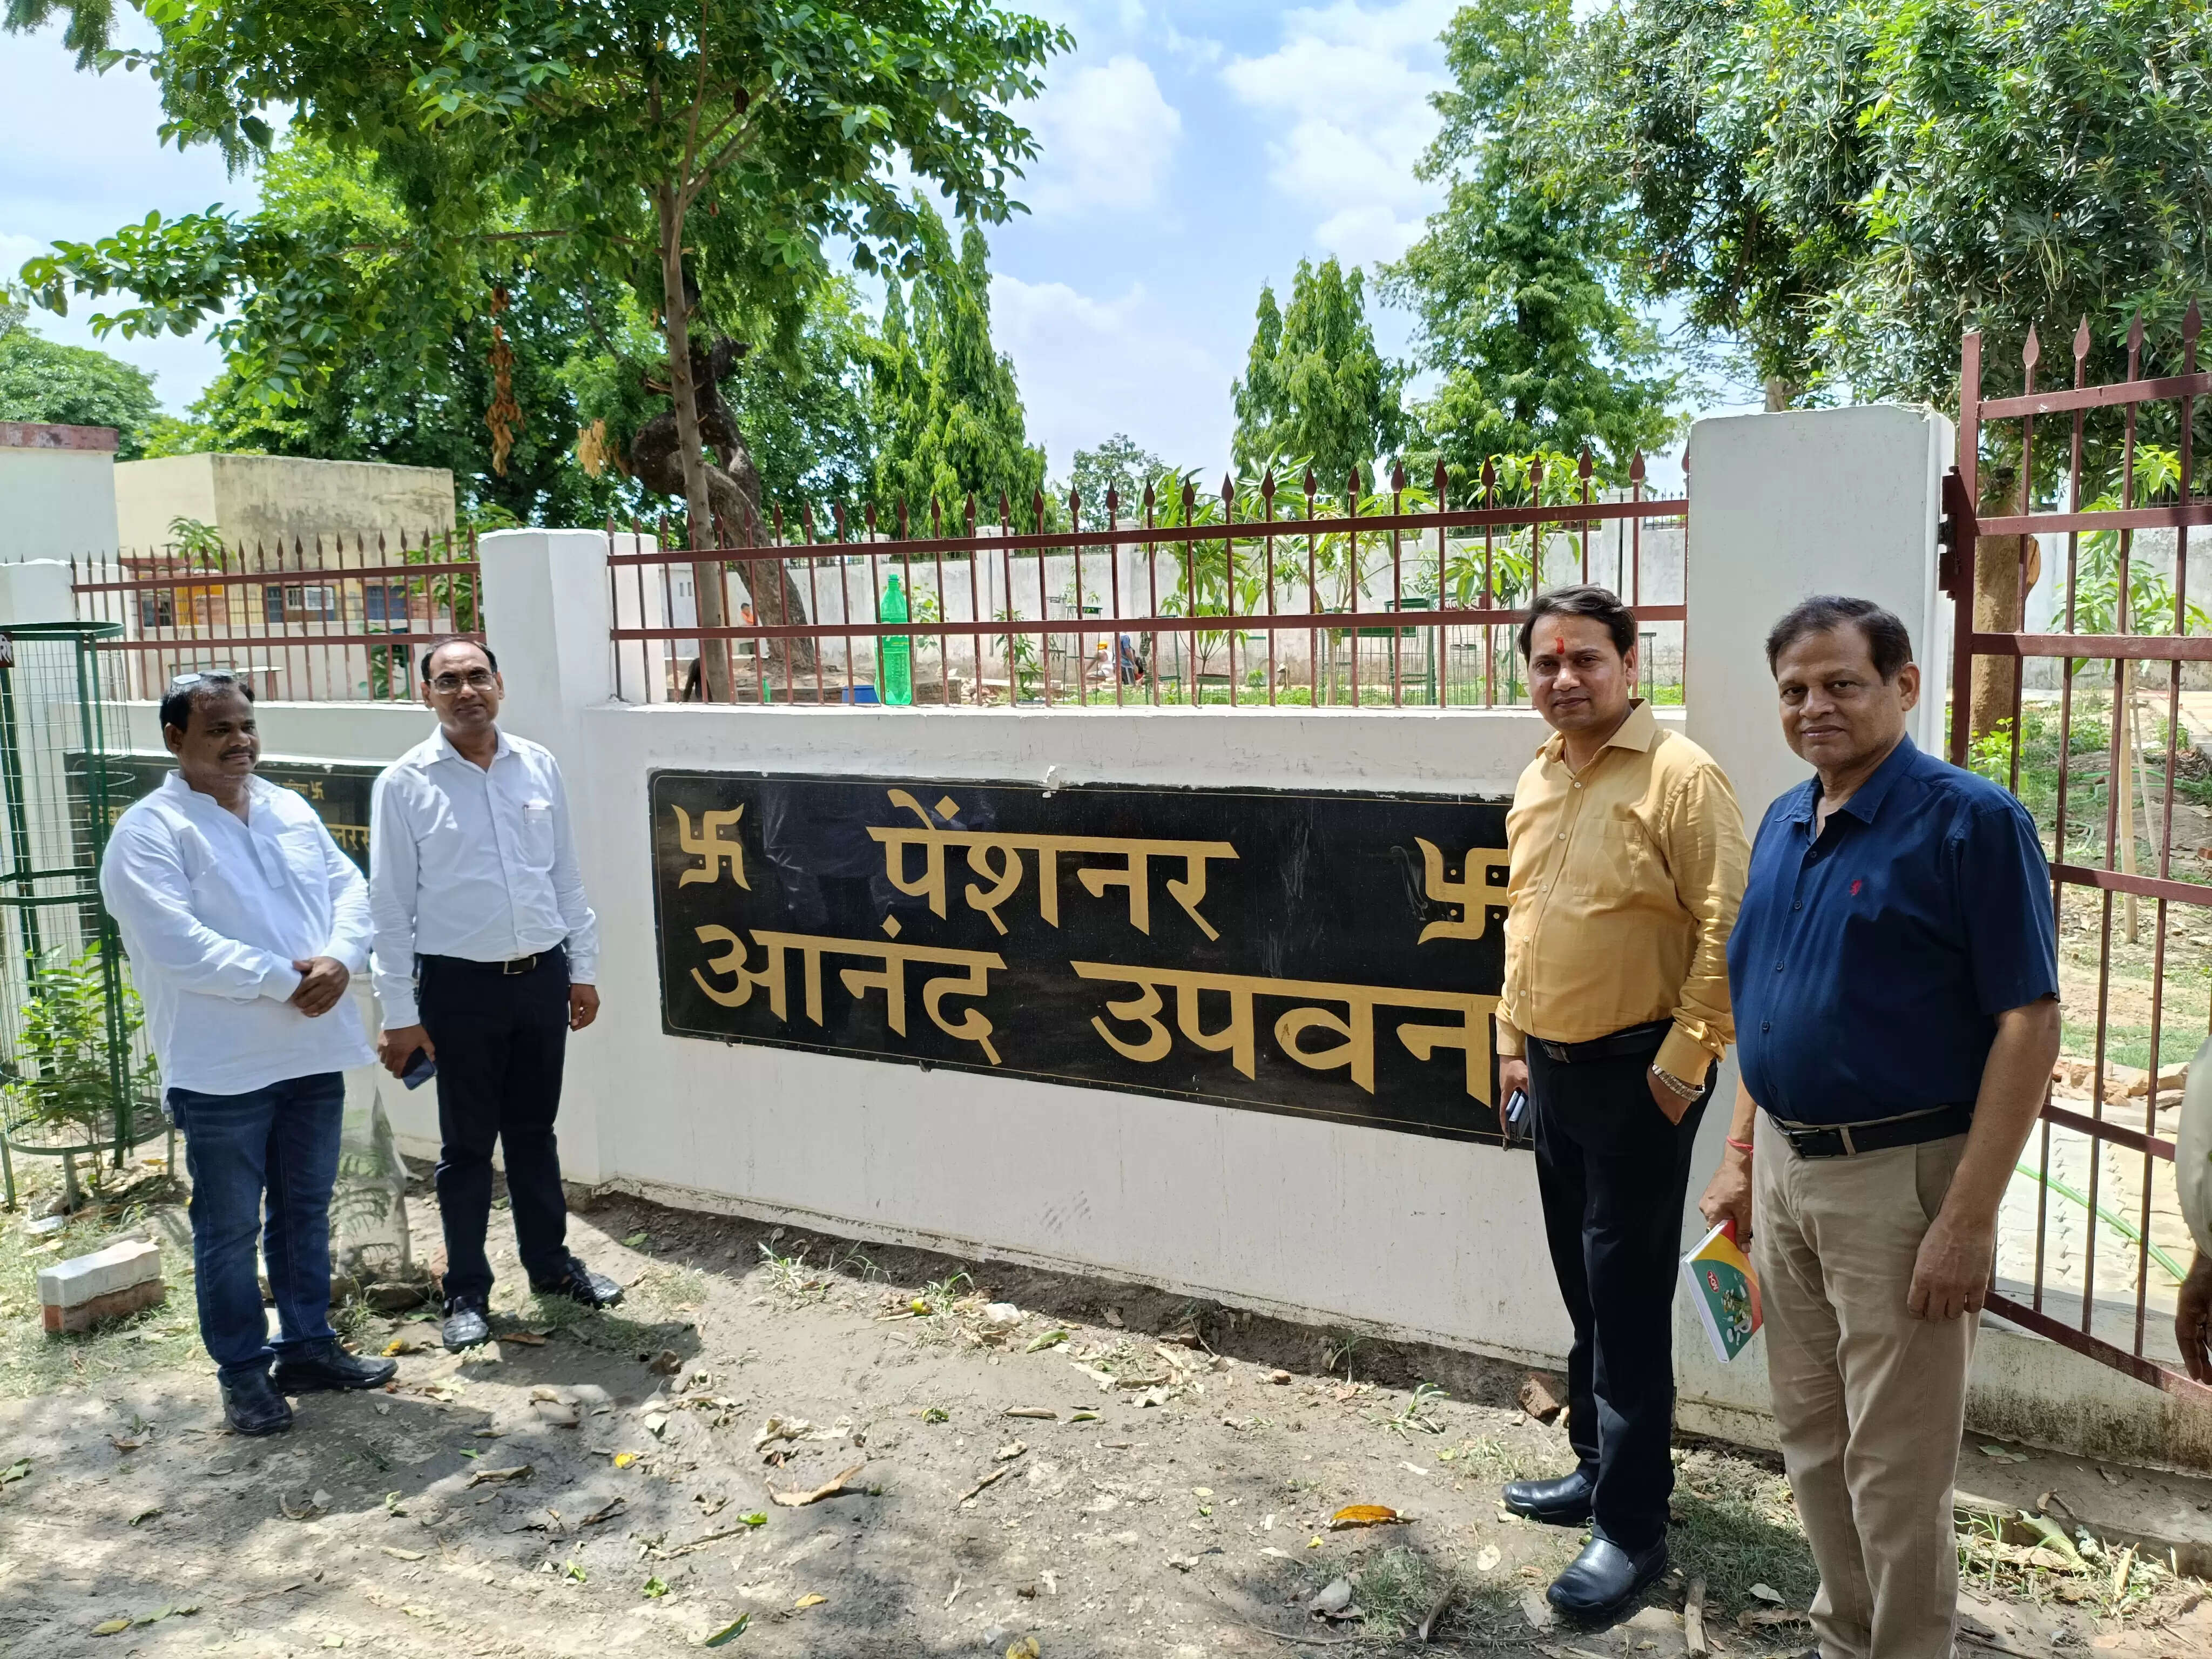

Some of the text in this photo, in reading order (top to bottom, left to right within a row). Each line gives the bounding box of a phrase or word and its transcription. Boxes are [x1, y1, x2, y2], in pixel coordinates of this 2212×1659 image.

[866, 789, 1240, 941] पेंशनर
[691, 914, 1502, 1109] आनंद उपवन
